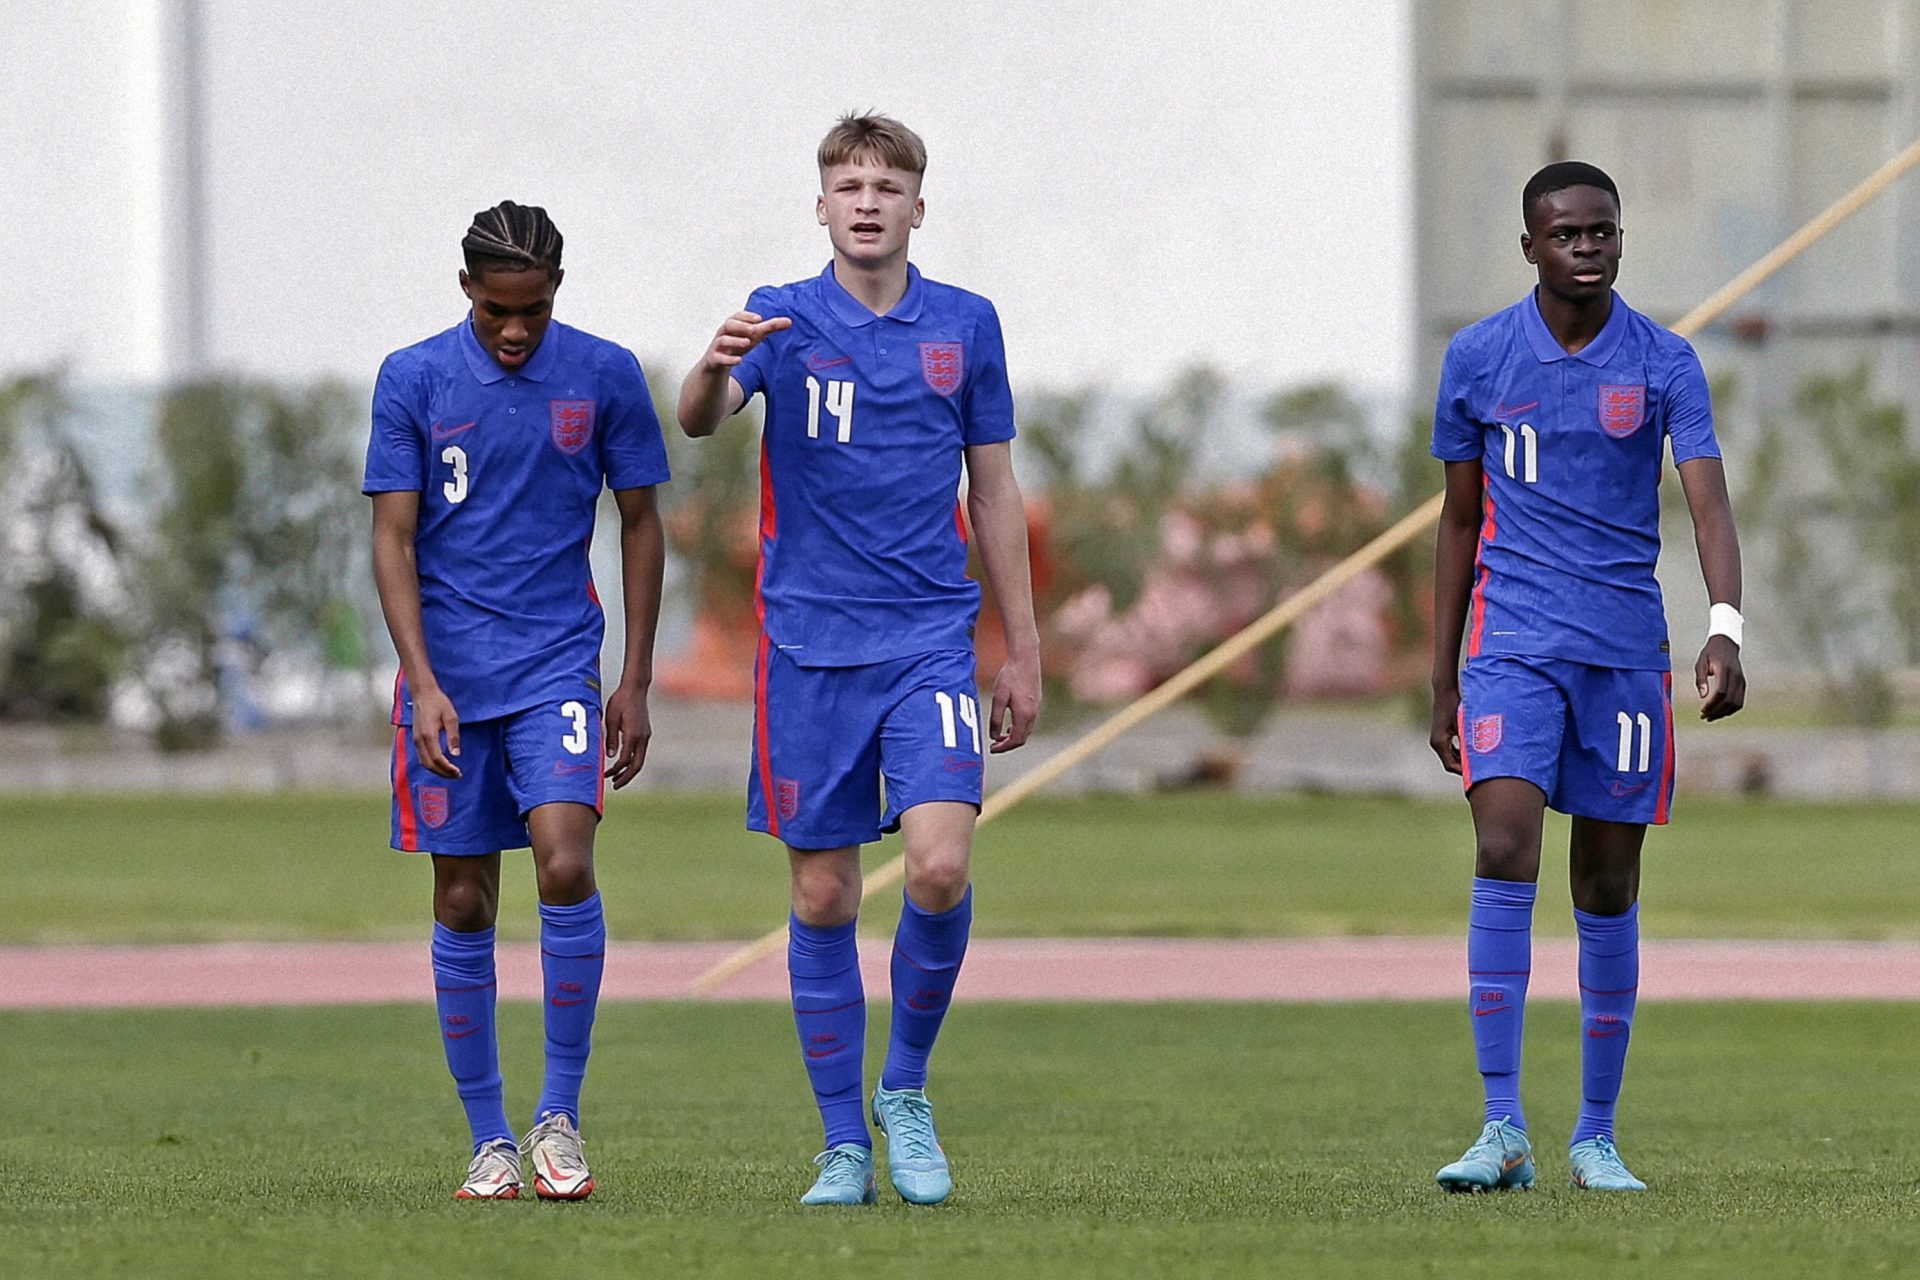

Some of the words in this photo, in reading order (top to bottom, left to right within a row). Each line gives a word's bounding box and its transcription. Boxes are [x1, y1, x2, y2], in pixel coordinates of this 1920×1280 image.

[806, 375, 855, 443] 14
[442, 446, 468, 504] 3
[1501, 424, 1537, 483] 11
[561, 700, 588, 755] 3
[934, 691, 980, 755] 14
[1617, 711, 1651, 773] 11
